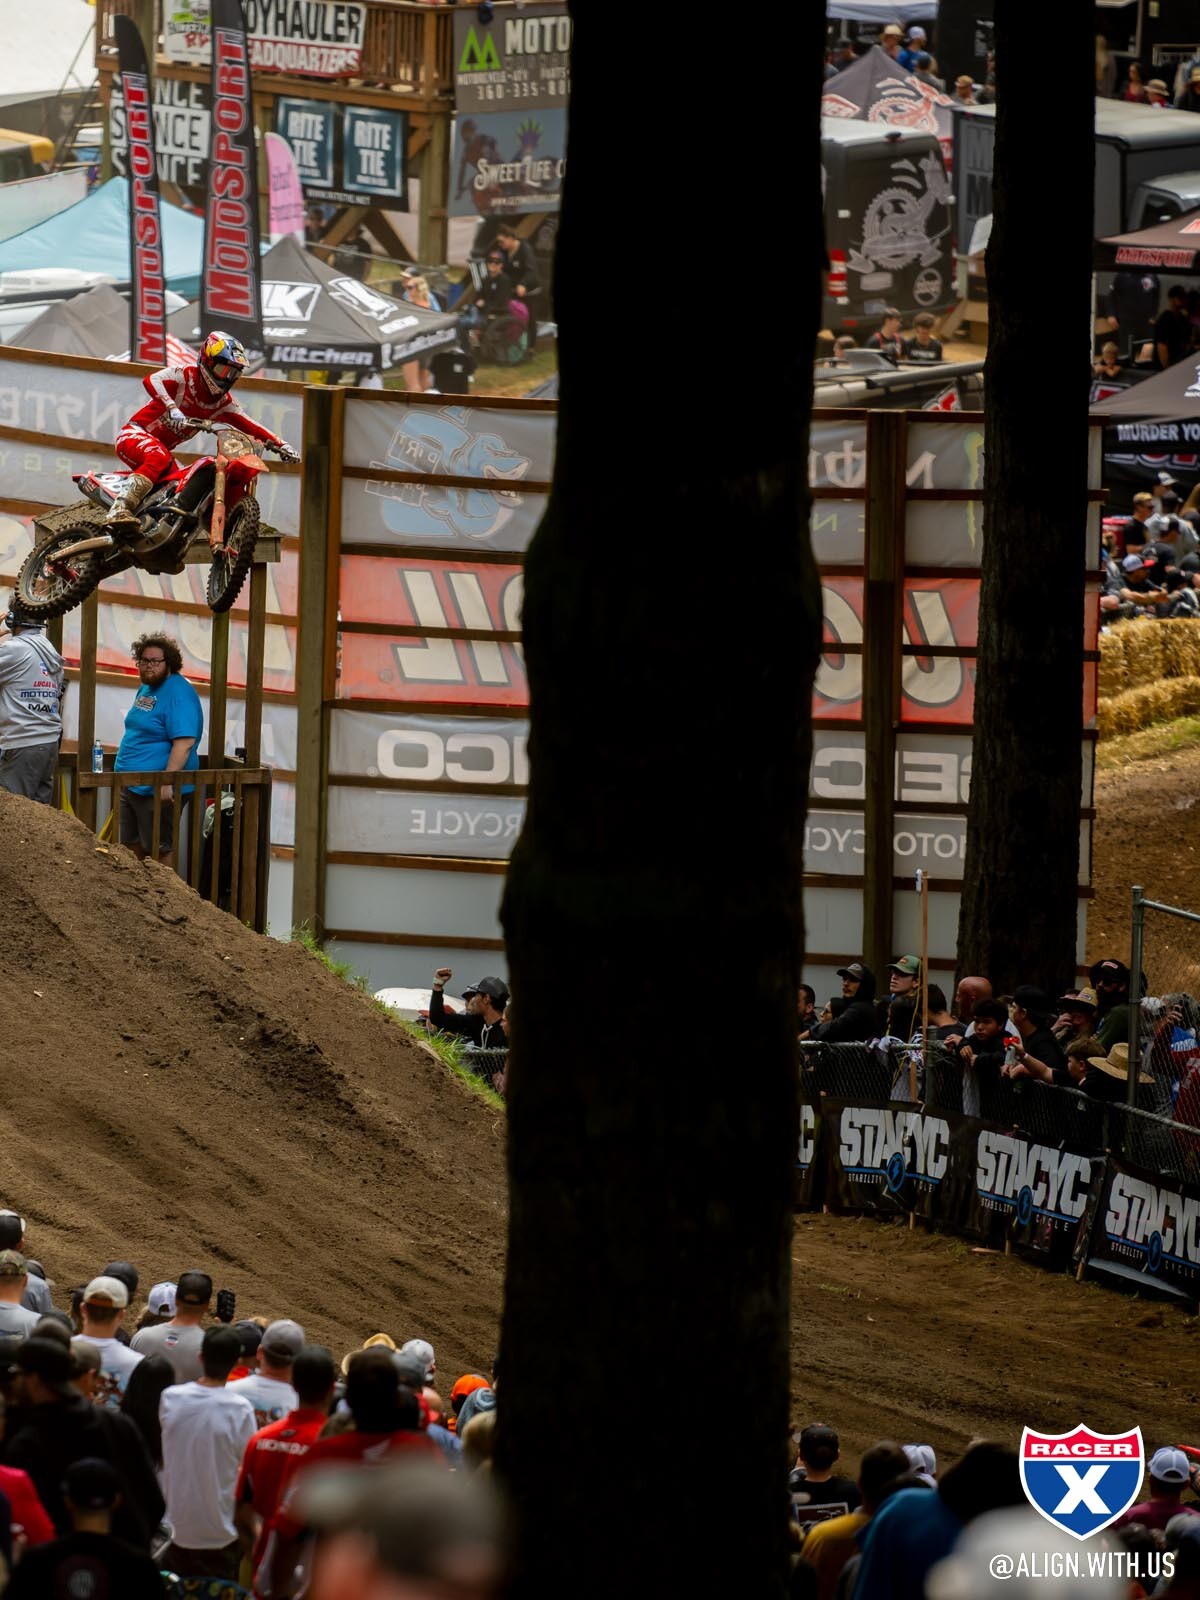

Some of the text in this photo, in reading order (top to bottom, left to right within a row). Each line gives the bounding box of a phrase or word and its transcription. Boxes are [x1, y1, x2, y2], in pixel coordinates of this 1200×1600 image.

[246, 2, 361, 45] OYHAULER
[206, 27, 257, 321] MOTOSPORT
[122, 71, 165, 364] MOTOSPORT
[272, 345, 373, 366] Kitchen
[1117, 424, 1179, 442] MURDER
[840, 1107, 949, 1179] STACYC
[976, 1130, 1091, 1218] STACYC
